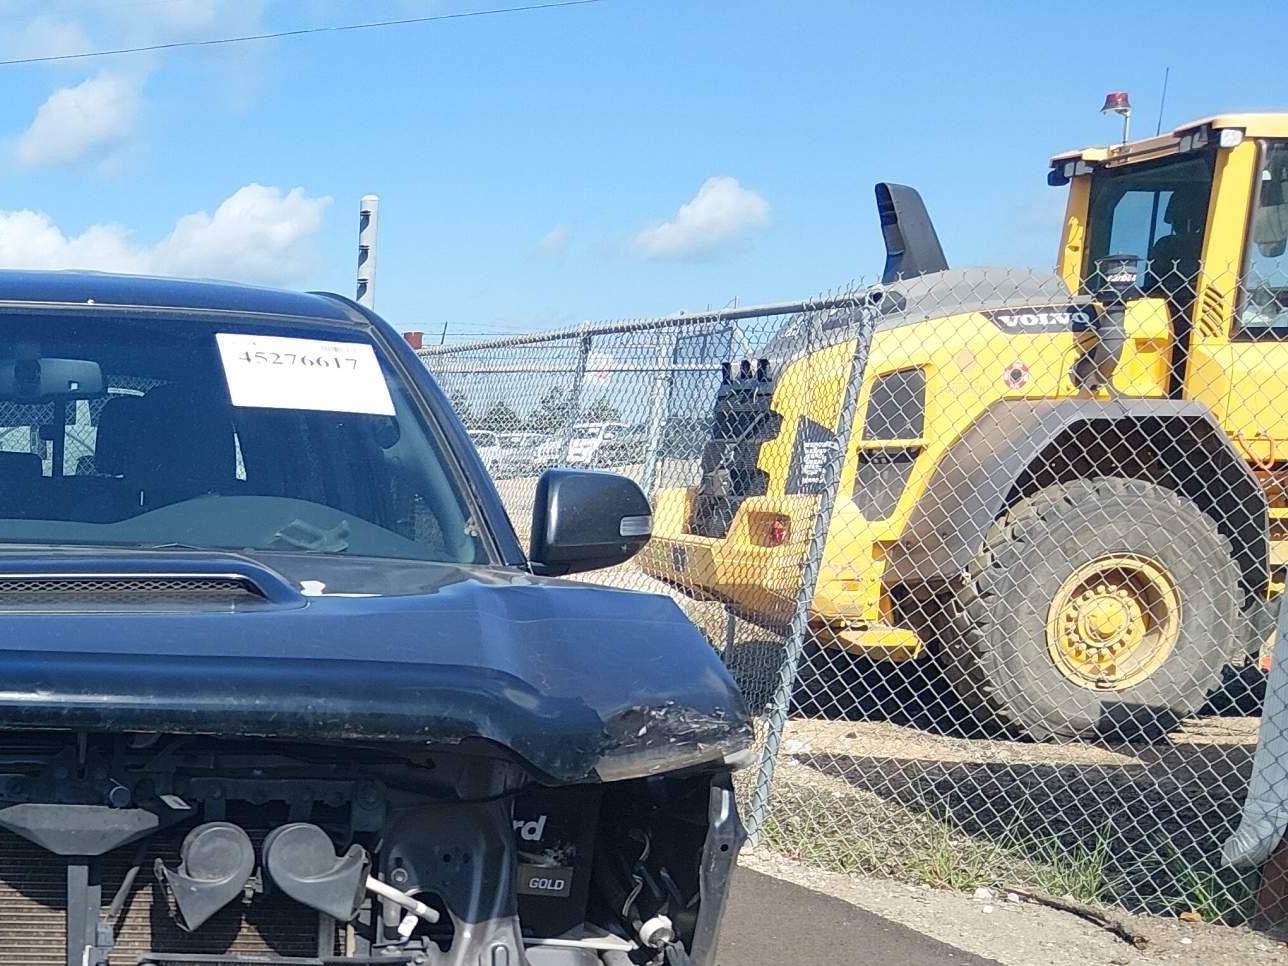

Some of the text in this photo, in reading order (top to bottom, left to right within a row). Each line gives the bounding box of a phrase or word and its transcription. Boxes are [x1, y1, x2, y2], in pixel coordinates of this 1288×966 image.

[998, 312, 1090, 327] VOLVO
[239, 350, 358, 371] 45276617
[529, 878, 565, 890] GOLD
